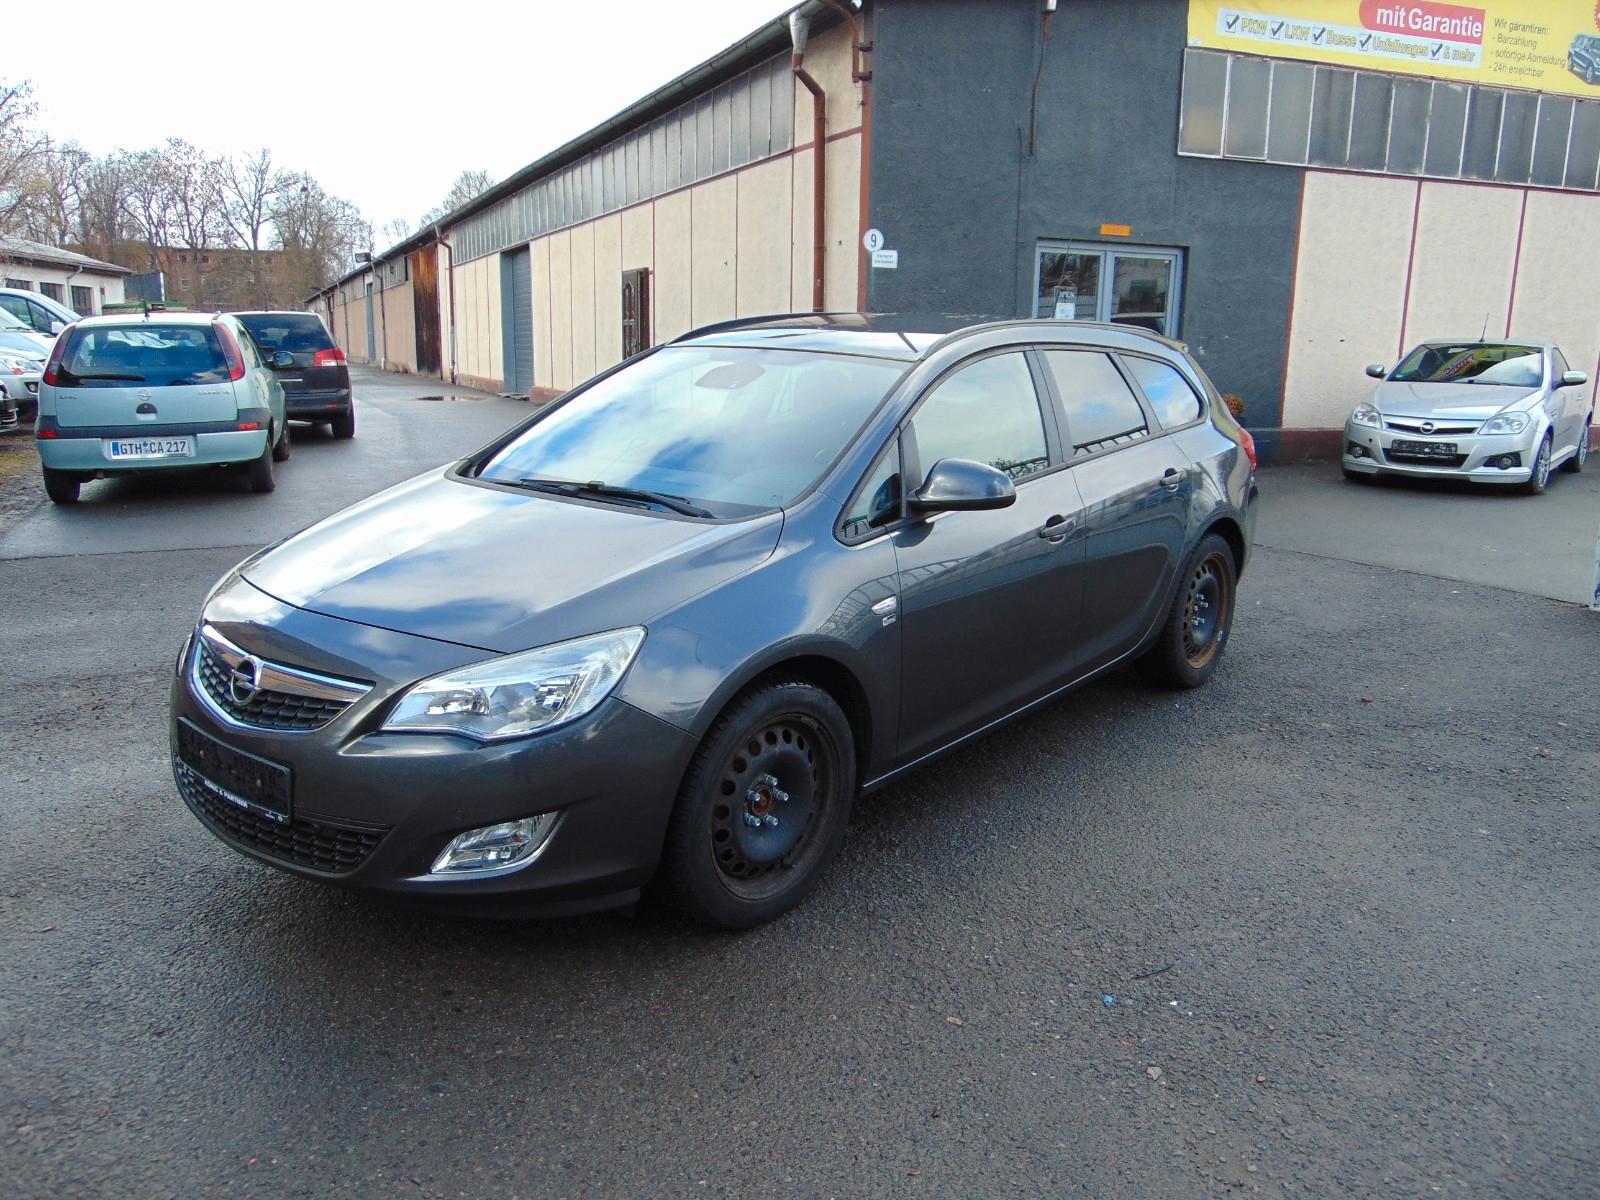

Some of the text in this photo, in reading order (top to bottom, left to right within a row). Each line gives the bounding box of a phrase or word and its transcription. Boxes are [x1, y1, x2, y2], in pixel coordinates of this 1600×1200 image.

[1376, 6, 1482, 38] mit Garantie
[1494, 18, 1507, 29] Wir
[1241, 18, 1267, 34] PKW
[1284, 24, 1310, 41] LKW
[1326, 29, 1357, 48] Busse
[1372, 35, 1428, 58] Unfallwagen
[1452, 48, 1475, 62] mehr
[1497, 33, 1537, 50] Barzahlung
[1495, 48, 1566, 69] sofortige Abmeldung
[1493, 62, 1545, 78] 24h erreichbar
[870, 233, 877, 248] 9
[120, 443, 142, 455] GTH
[149, 442, 164, 454] CA
[166, 441, 186, 453] 217
